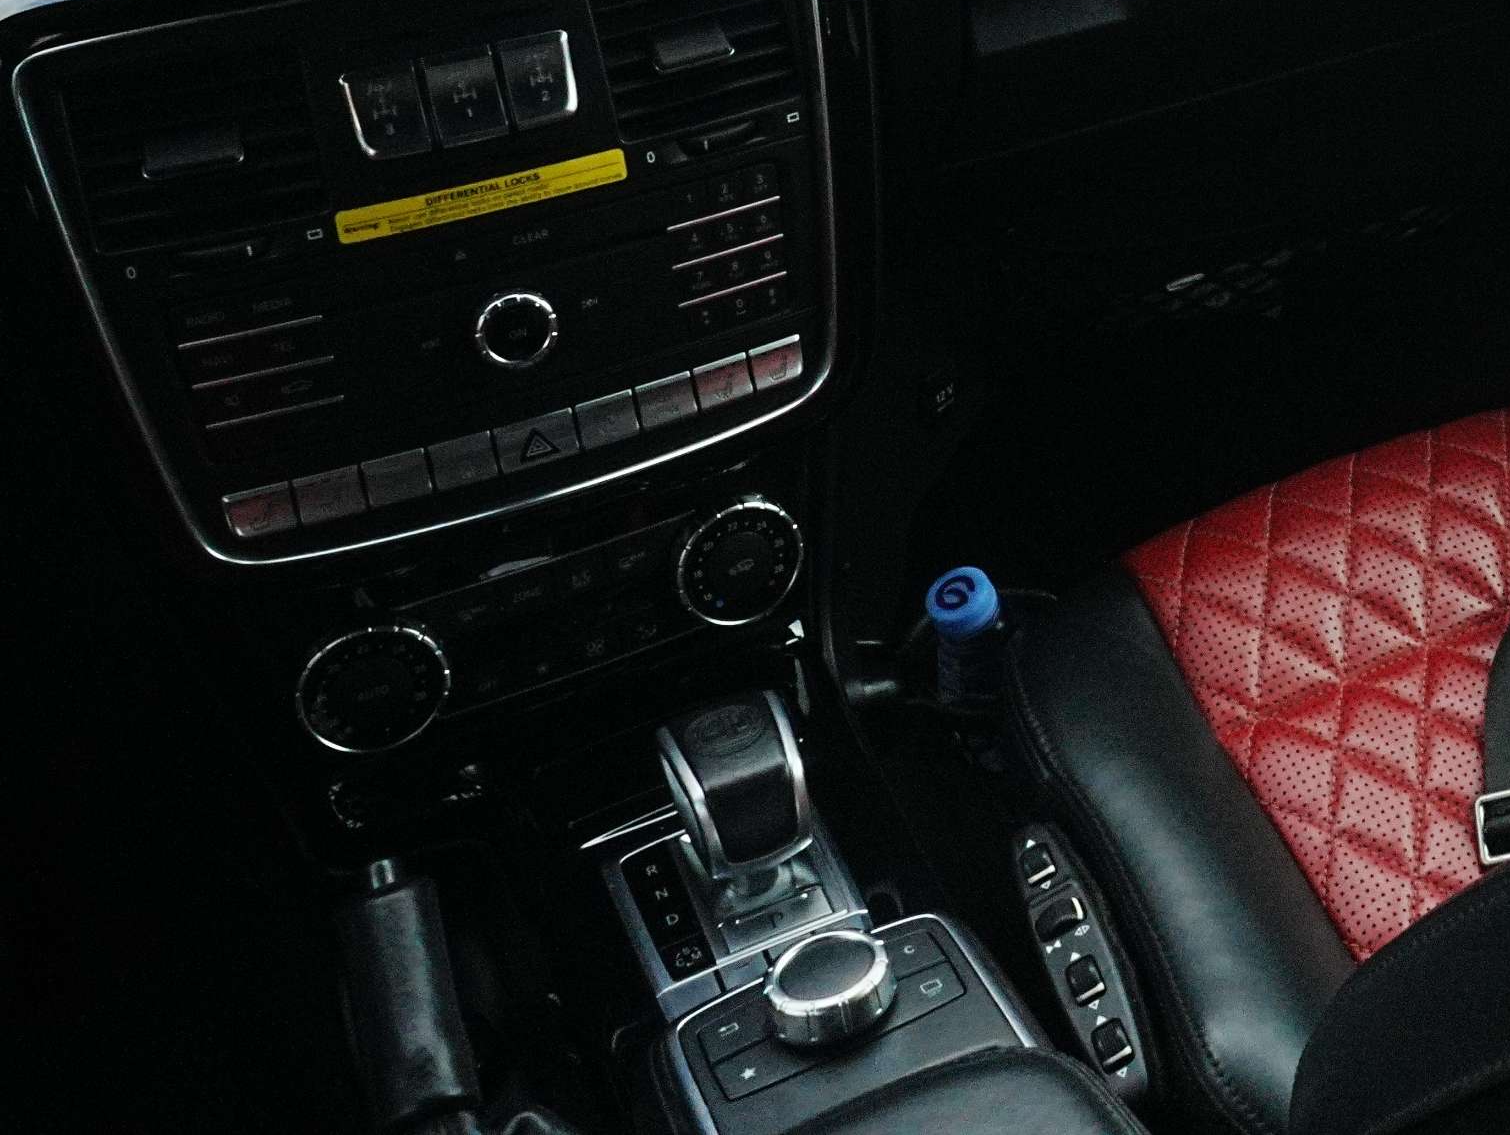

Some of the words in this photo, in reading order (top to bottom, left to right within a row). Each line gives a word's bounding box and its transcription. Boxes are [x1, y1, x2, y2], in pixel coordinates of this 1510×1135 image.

[425, 183, 501, 206] DIFFERENTIAL
[504, 172, 541, 190] LOCKS
[512, 228, 550, 246] CLEAR
[645, 864, 659, 877] R
[654, 887, 669, 901] N
[666, 913, 679, 927] D
